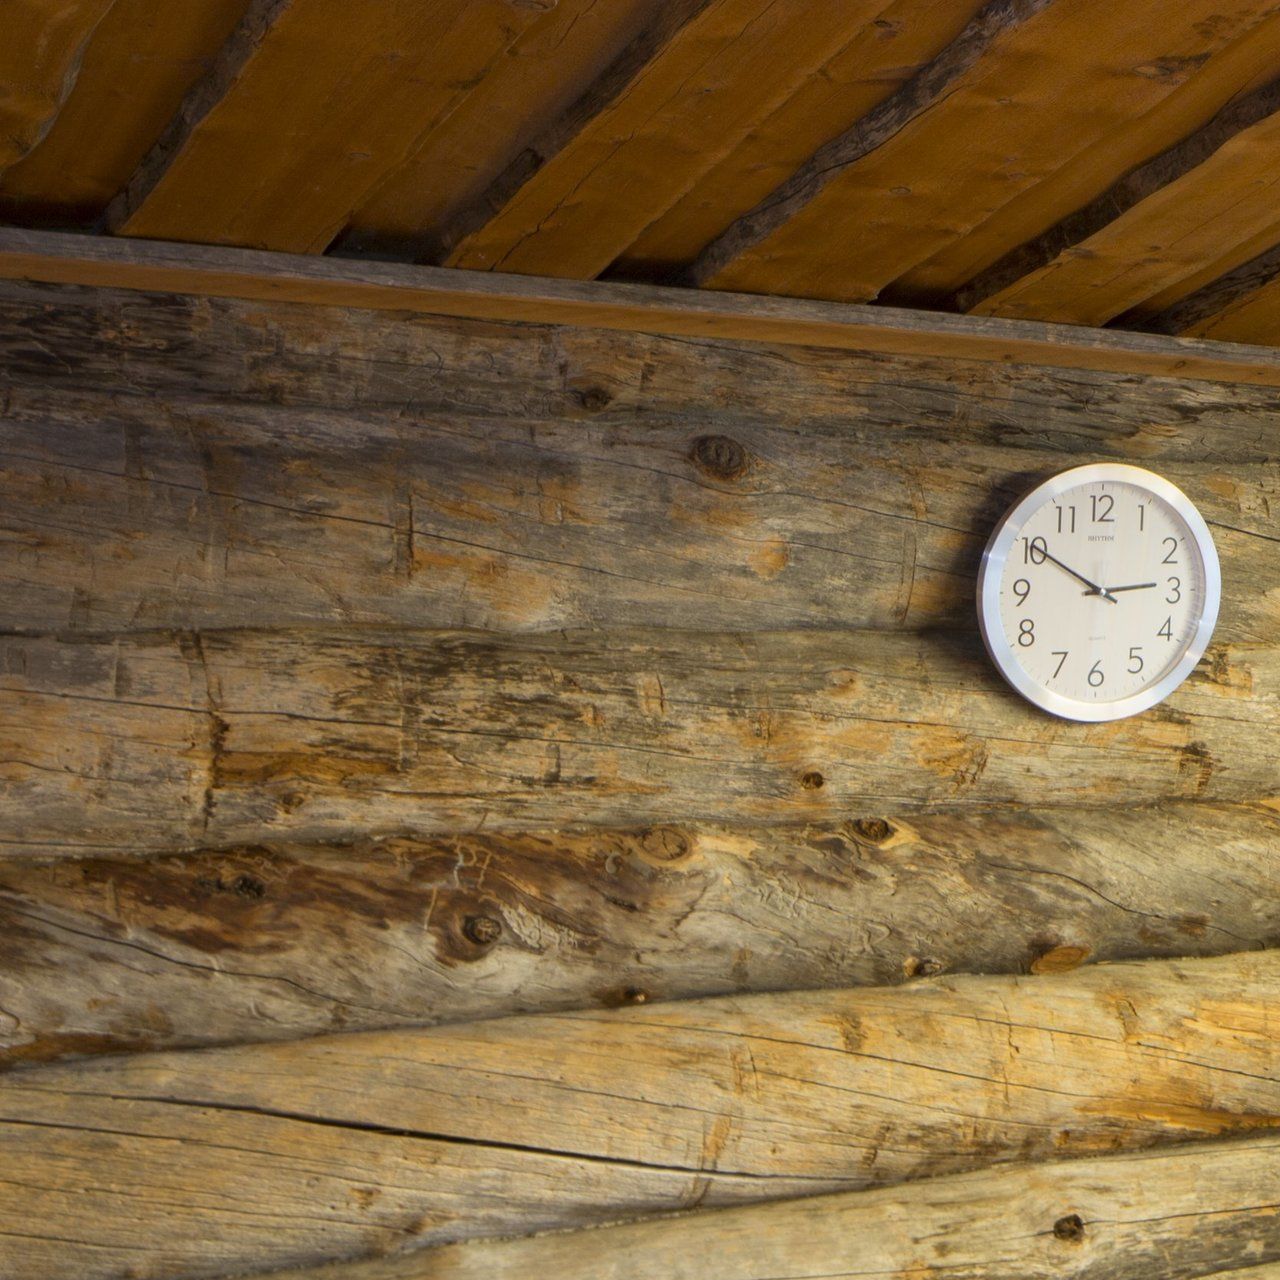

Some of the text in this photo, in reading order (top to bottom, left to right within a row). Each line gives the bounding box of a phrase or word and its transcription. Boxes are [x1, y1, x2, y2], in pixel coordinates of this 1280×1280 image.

[1055, 505, 1077, 534] 11
[1090, 494, 1115, 523] 12
[1137, 504, 1145, 532] 1
[1021, 536, 1048, 565] 10
[1161, 536, 1179, 564] 2
[1013, 578, 1031, 607] 9
[1165, 576, 1181, 604] 3
[1018, 618, 1035, 648] 8
[1156, 615, 1173, 642] 4
[1051, 651, 1070, 679] 7
[1087, 659, 1105, 687] 6
[1126, 646, 1144, 674] 5
